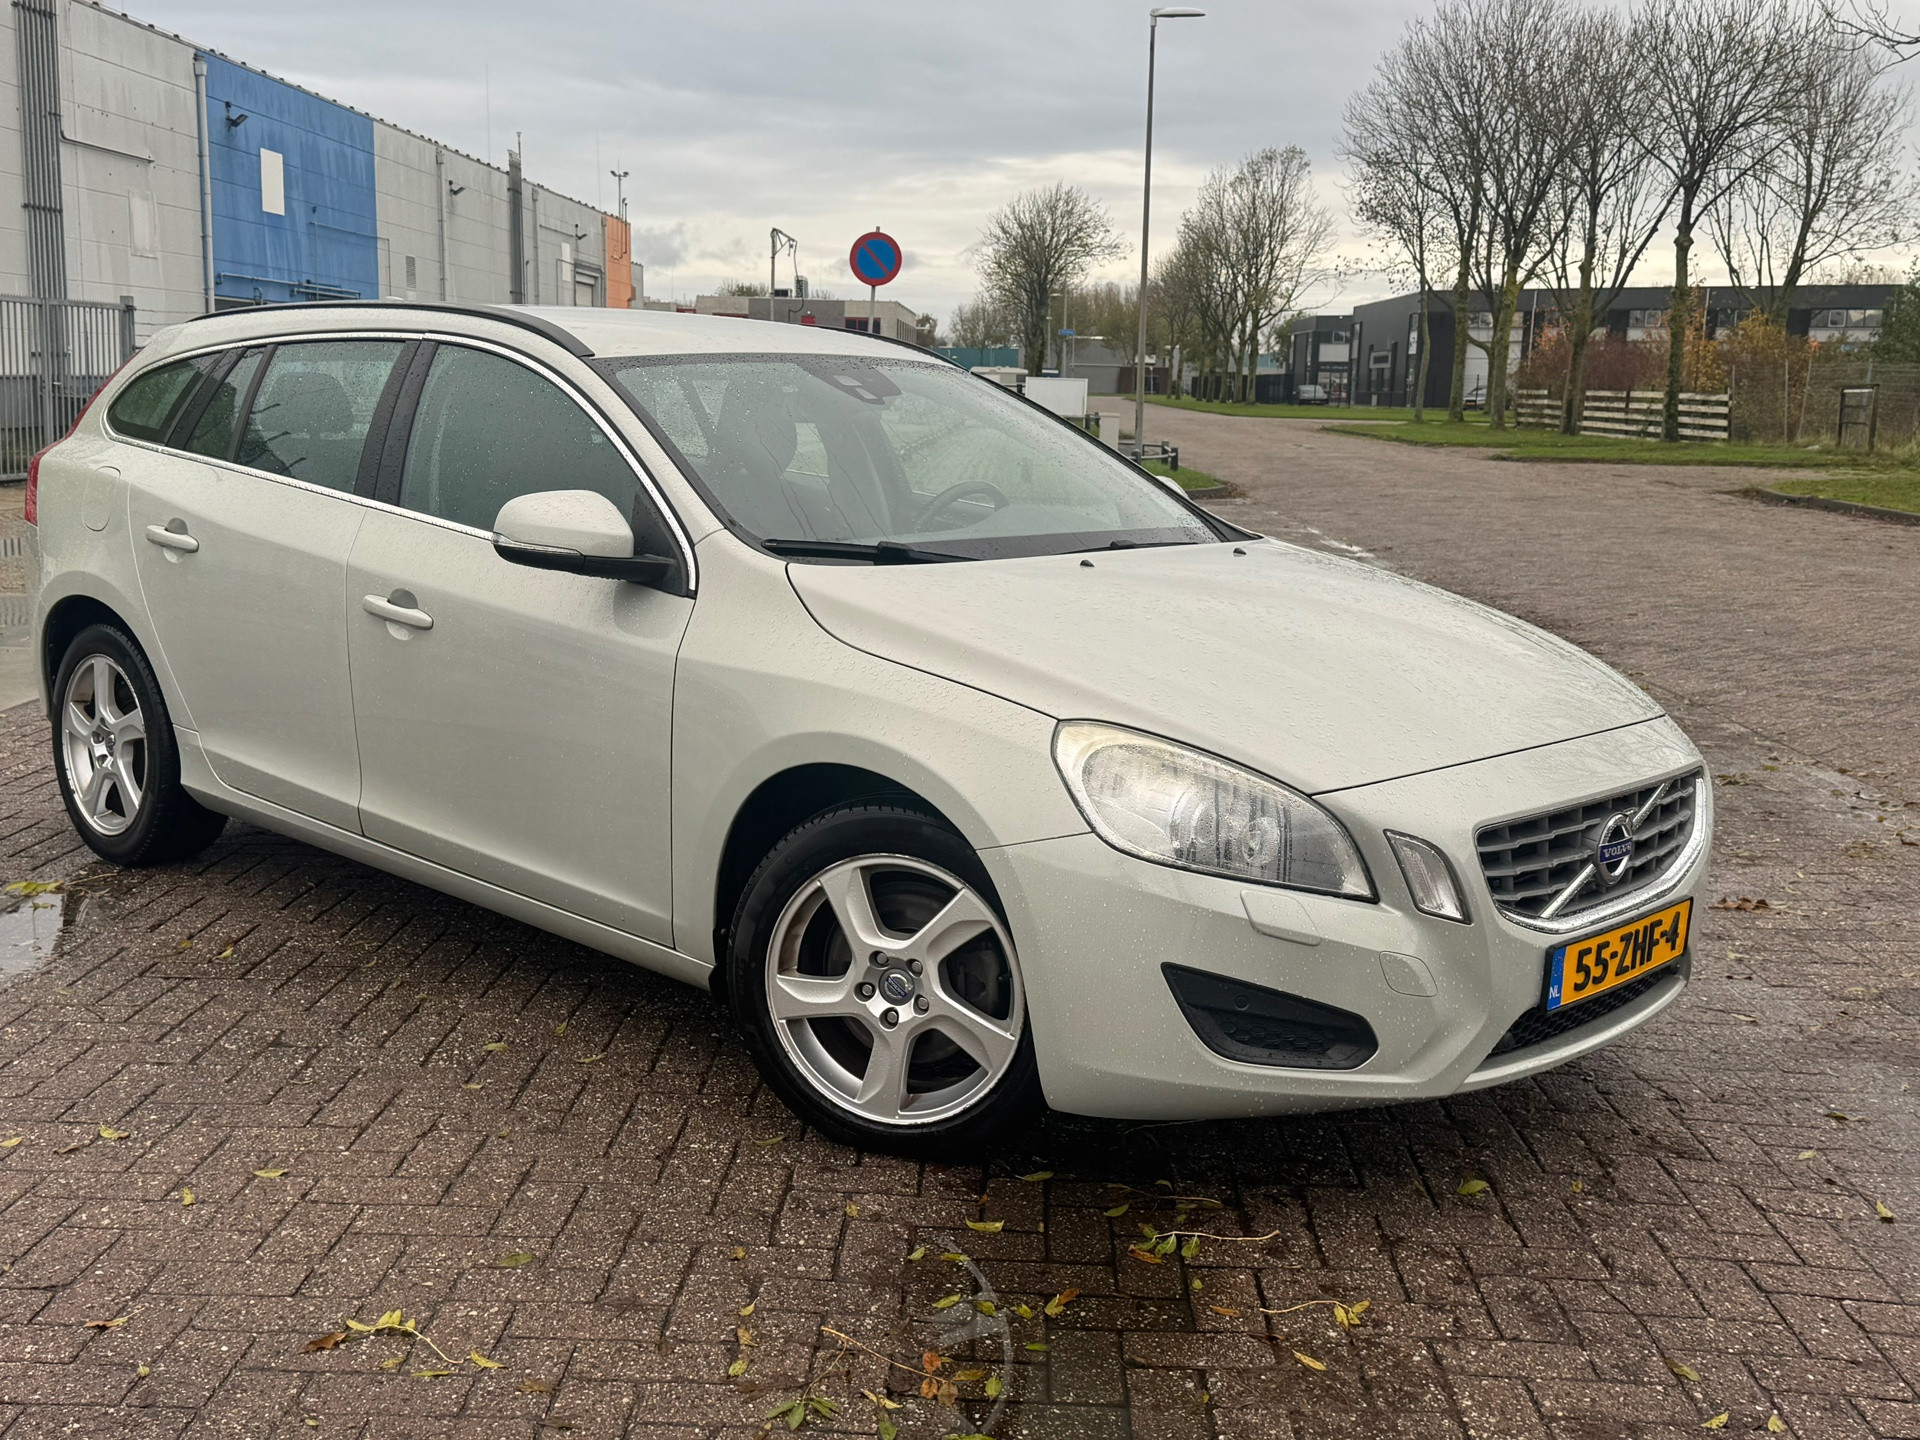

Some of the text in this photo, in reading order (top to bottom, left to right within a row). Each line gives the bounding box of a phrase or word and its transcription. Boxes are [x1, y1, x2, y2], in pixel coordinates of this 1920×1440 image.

[1603, 842, 1631, 858] VOLVO
[1573, 911, 1681, 992] 55-ZHF-4
[1549, 985, 1560, 999] NL
